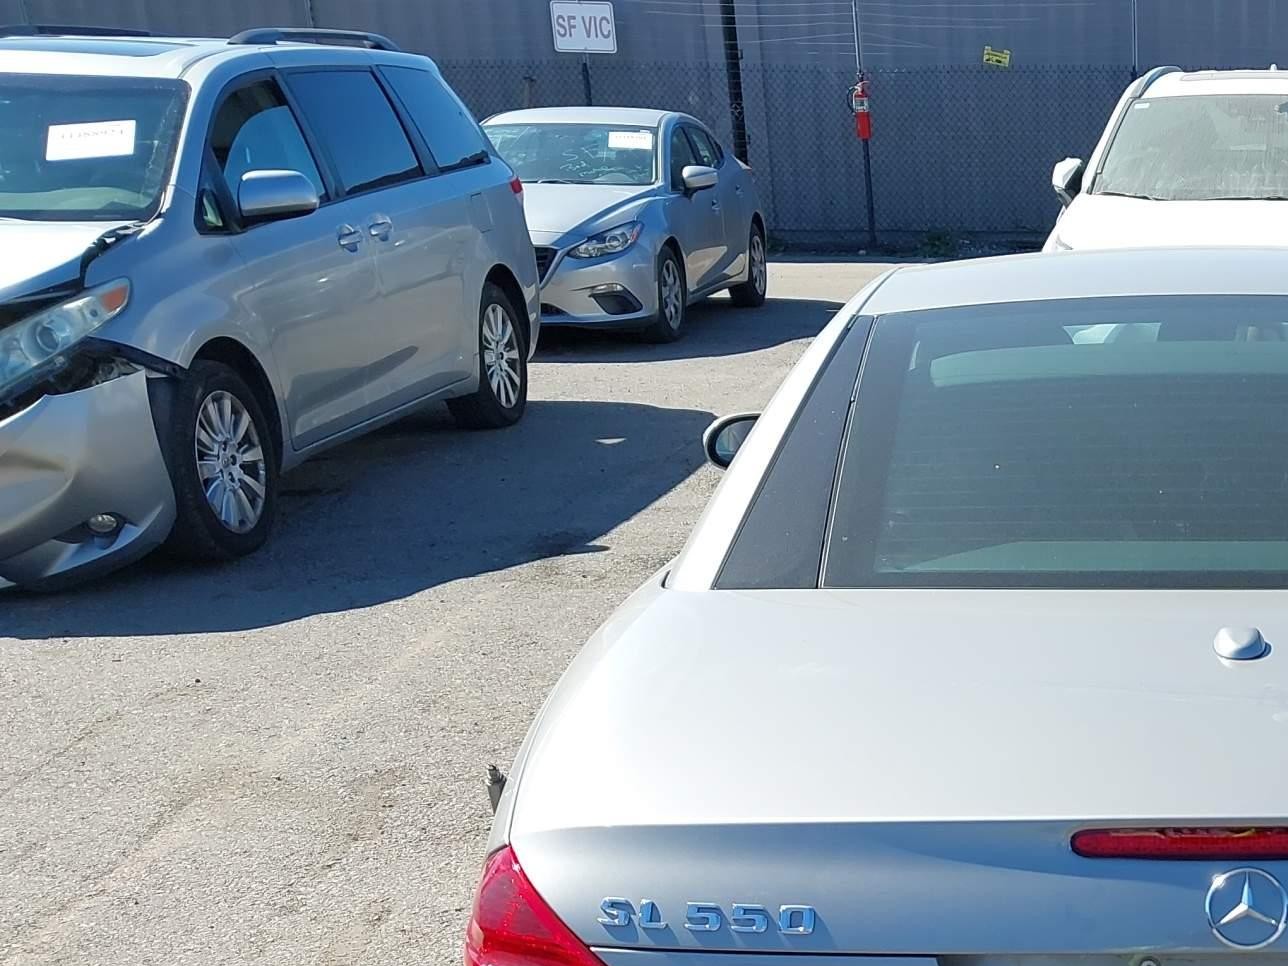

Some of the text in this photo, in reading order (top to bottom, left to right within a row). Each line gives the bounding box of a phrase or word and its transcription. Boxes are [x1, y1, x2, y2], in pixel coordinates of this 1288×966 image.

[556, 14, 611, 39] SF VIC
[597, 896, 817, 935] SL 550
